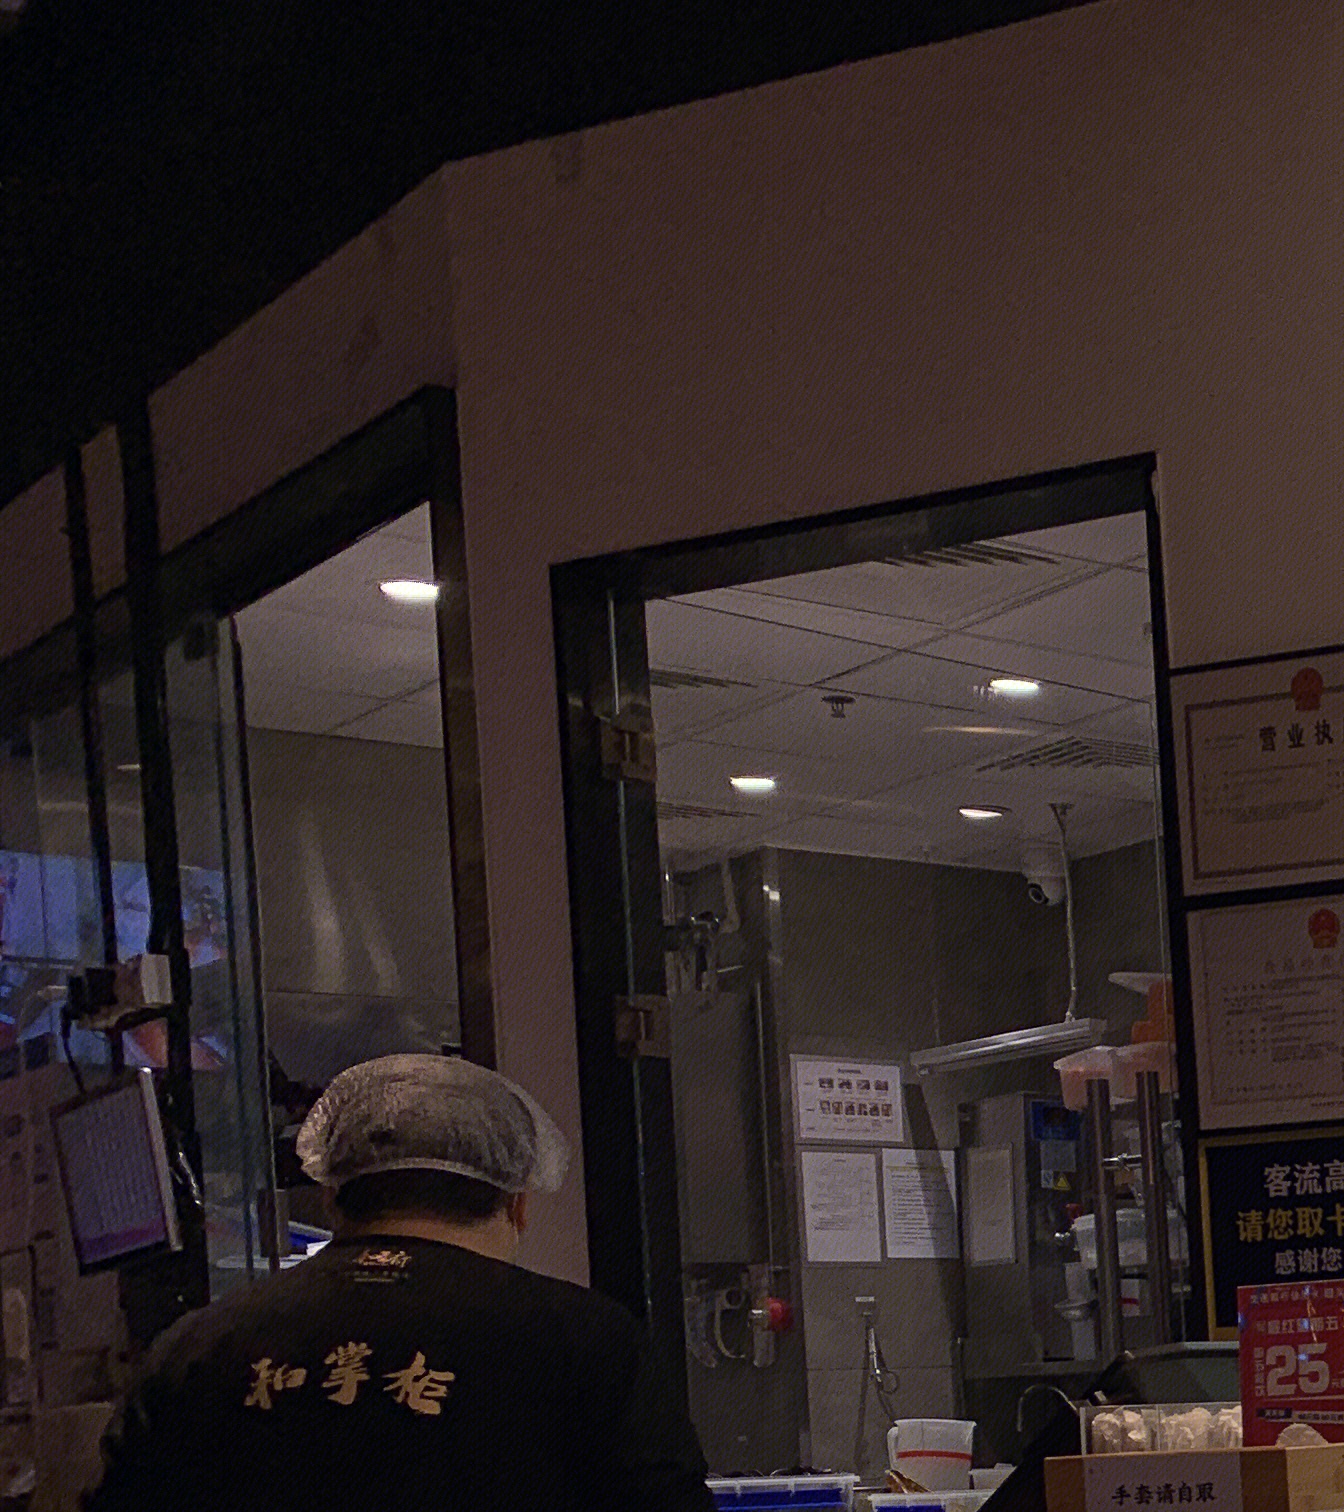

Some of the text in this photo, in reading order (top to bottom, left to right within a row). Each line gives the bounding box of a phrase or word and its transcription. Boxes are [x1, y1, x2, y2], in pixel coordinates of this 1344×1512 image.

[244, 1340, 456, 1416] 和掌柜
[1265, 1342, 1331, 1397] 25
[1111, 1480, 1217, 1507] 手套请自取
